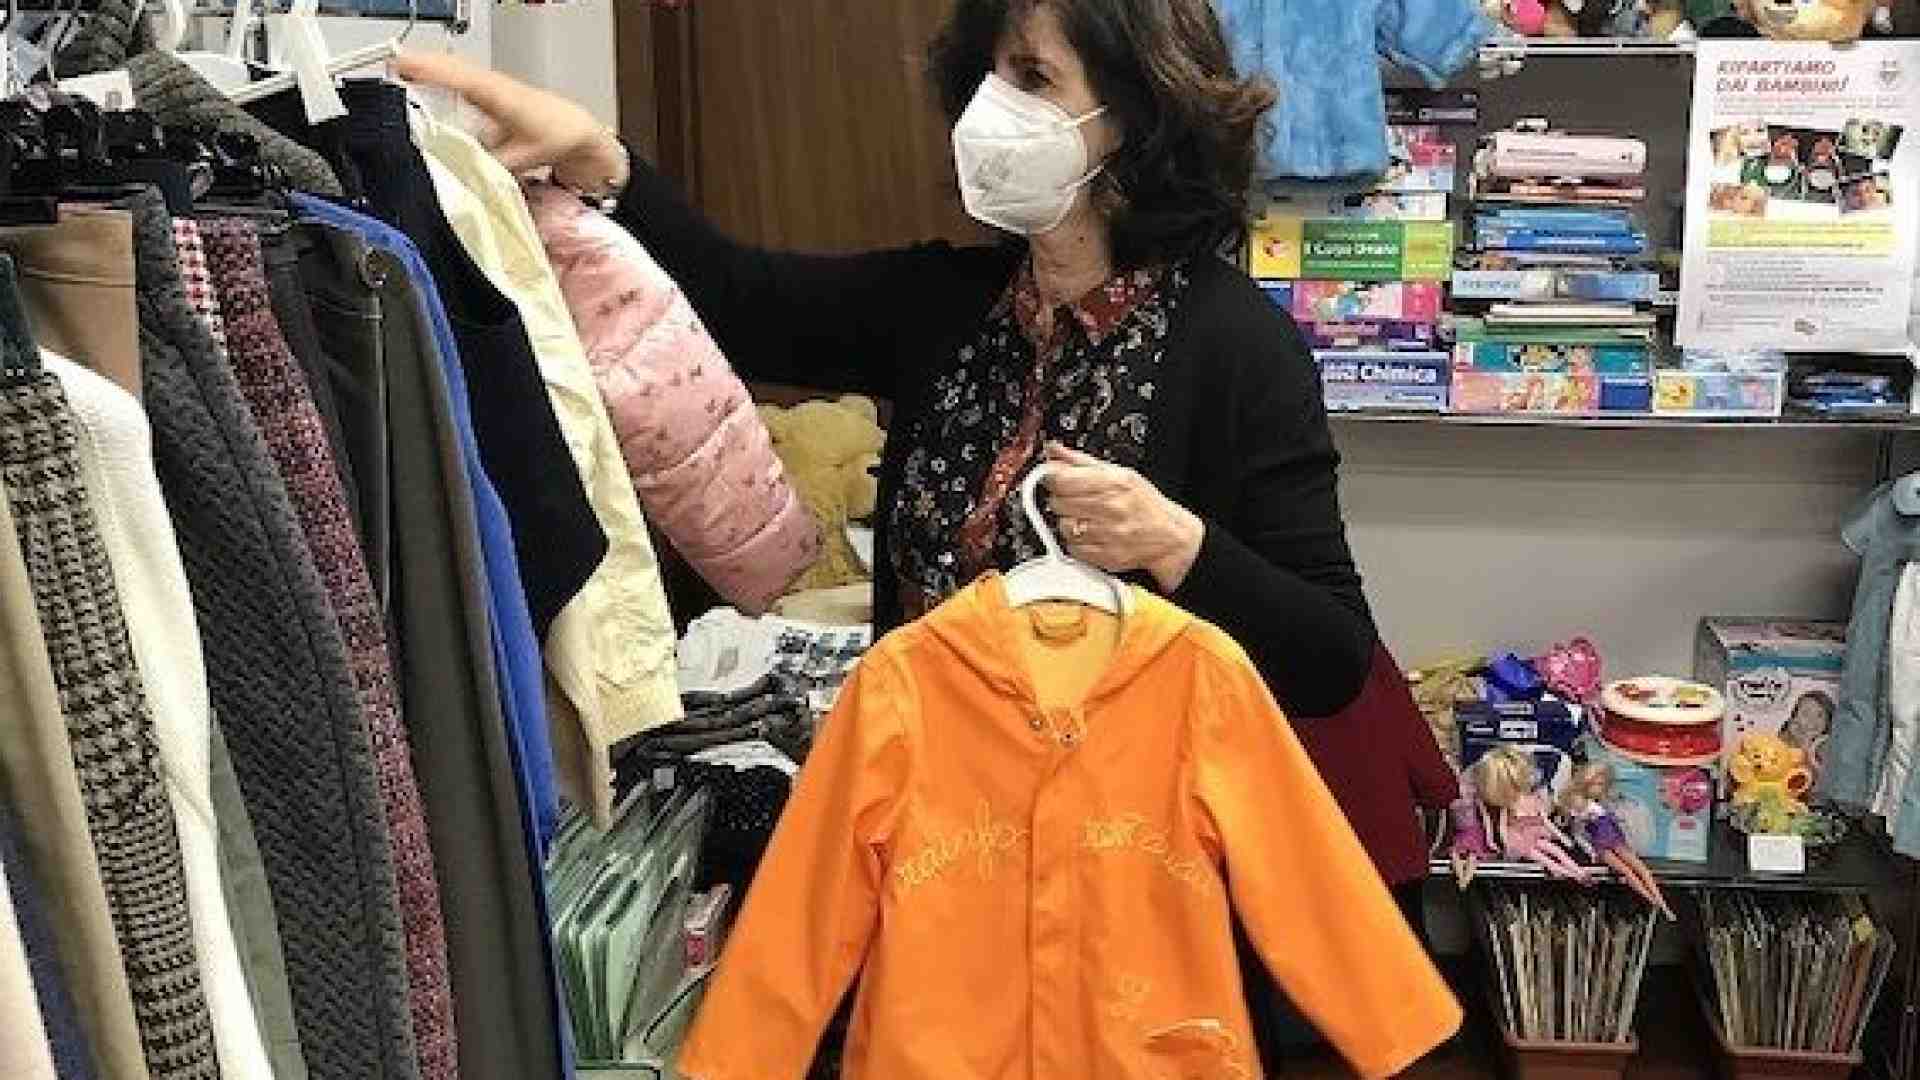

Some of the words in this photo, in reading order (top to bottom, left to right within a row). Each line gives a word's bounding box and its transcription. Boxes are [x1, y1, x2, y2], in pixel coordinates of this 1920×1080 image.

[1716, 60, 1837, 75] RIPARTIAMO
[1716, 78, 1748, 92] DAI
[1360, 361, 1438, 384] Chimica
